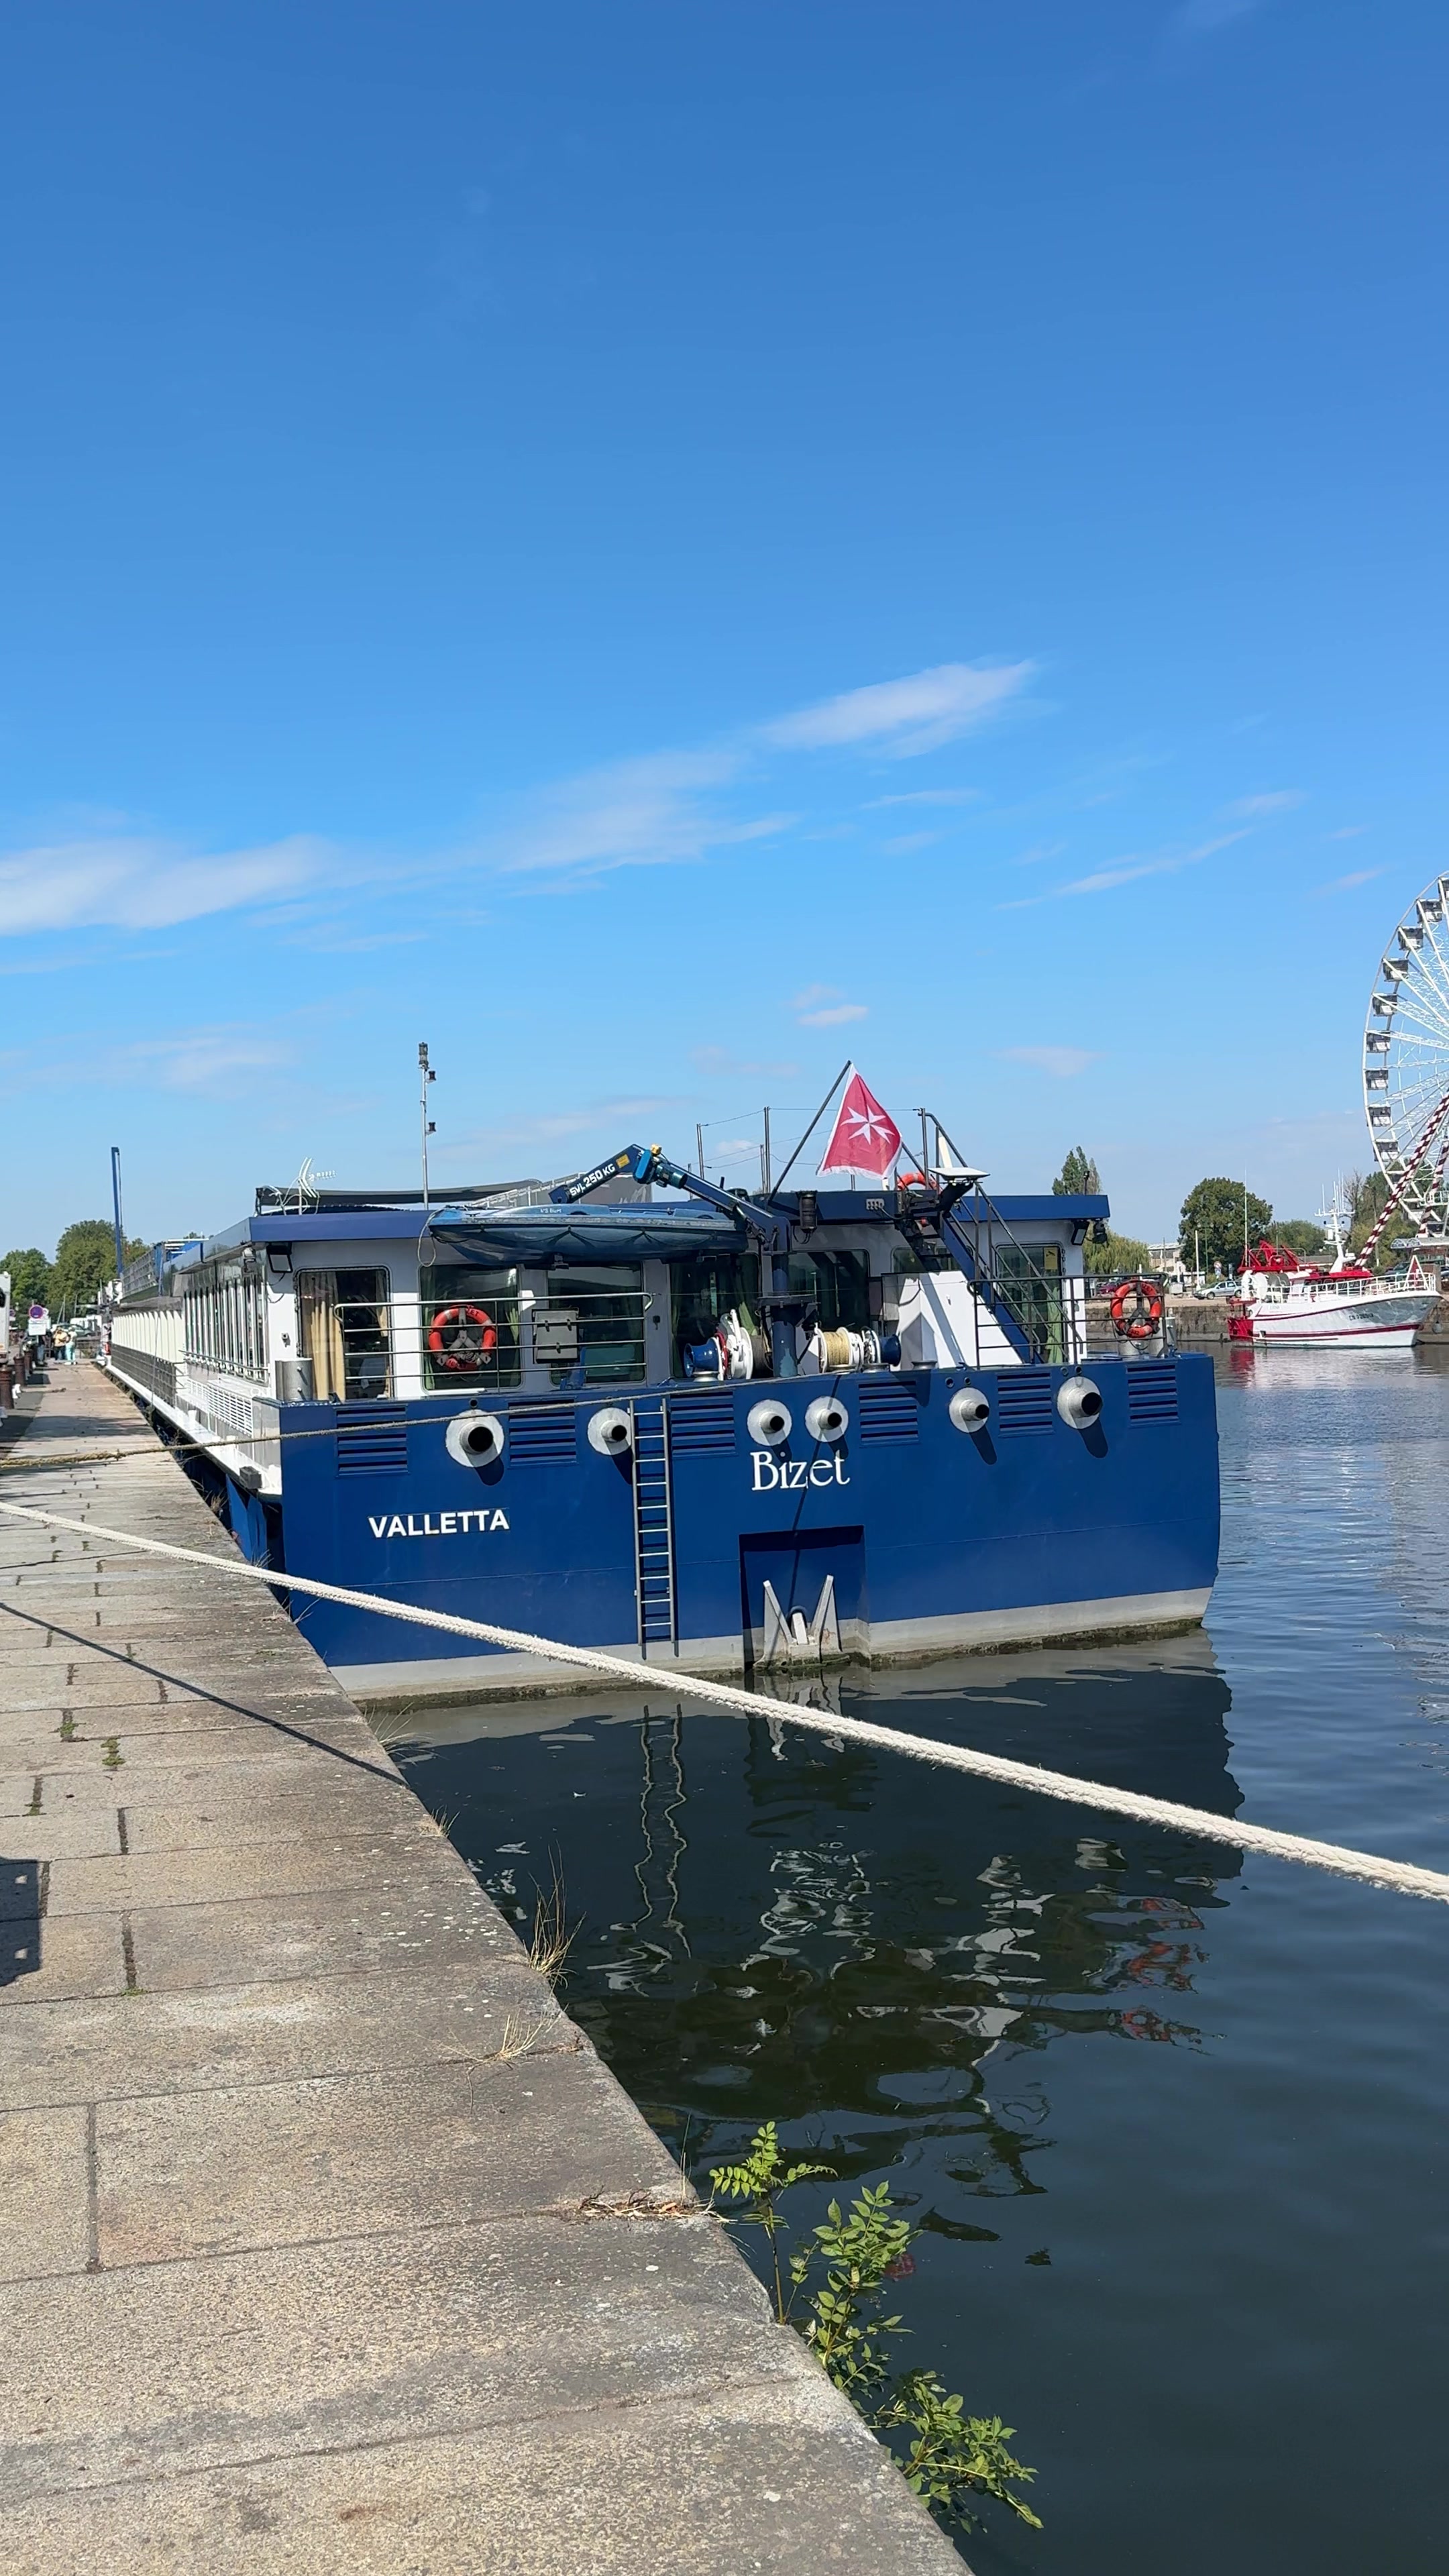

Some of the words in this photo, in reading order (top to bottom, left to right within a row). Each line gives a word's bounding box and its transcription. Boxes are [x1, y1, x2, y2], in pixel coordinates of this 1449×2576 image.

[583, 1170, 604, 1187] 250
[602, 1163, 616, 1177] KG
[750, 1450, 851, 1491] Bizet
[368, 1509, 509, 1538] VALLETTA
